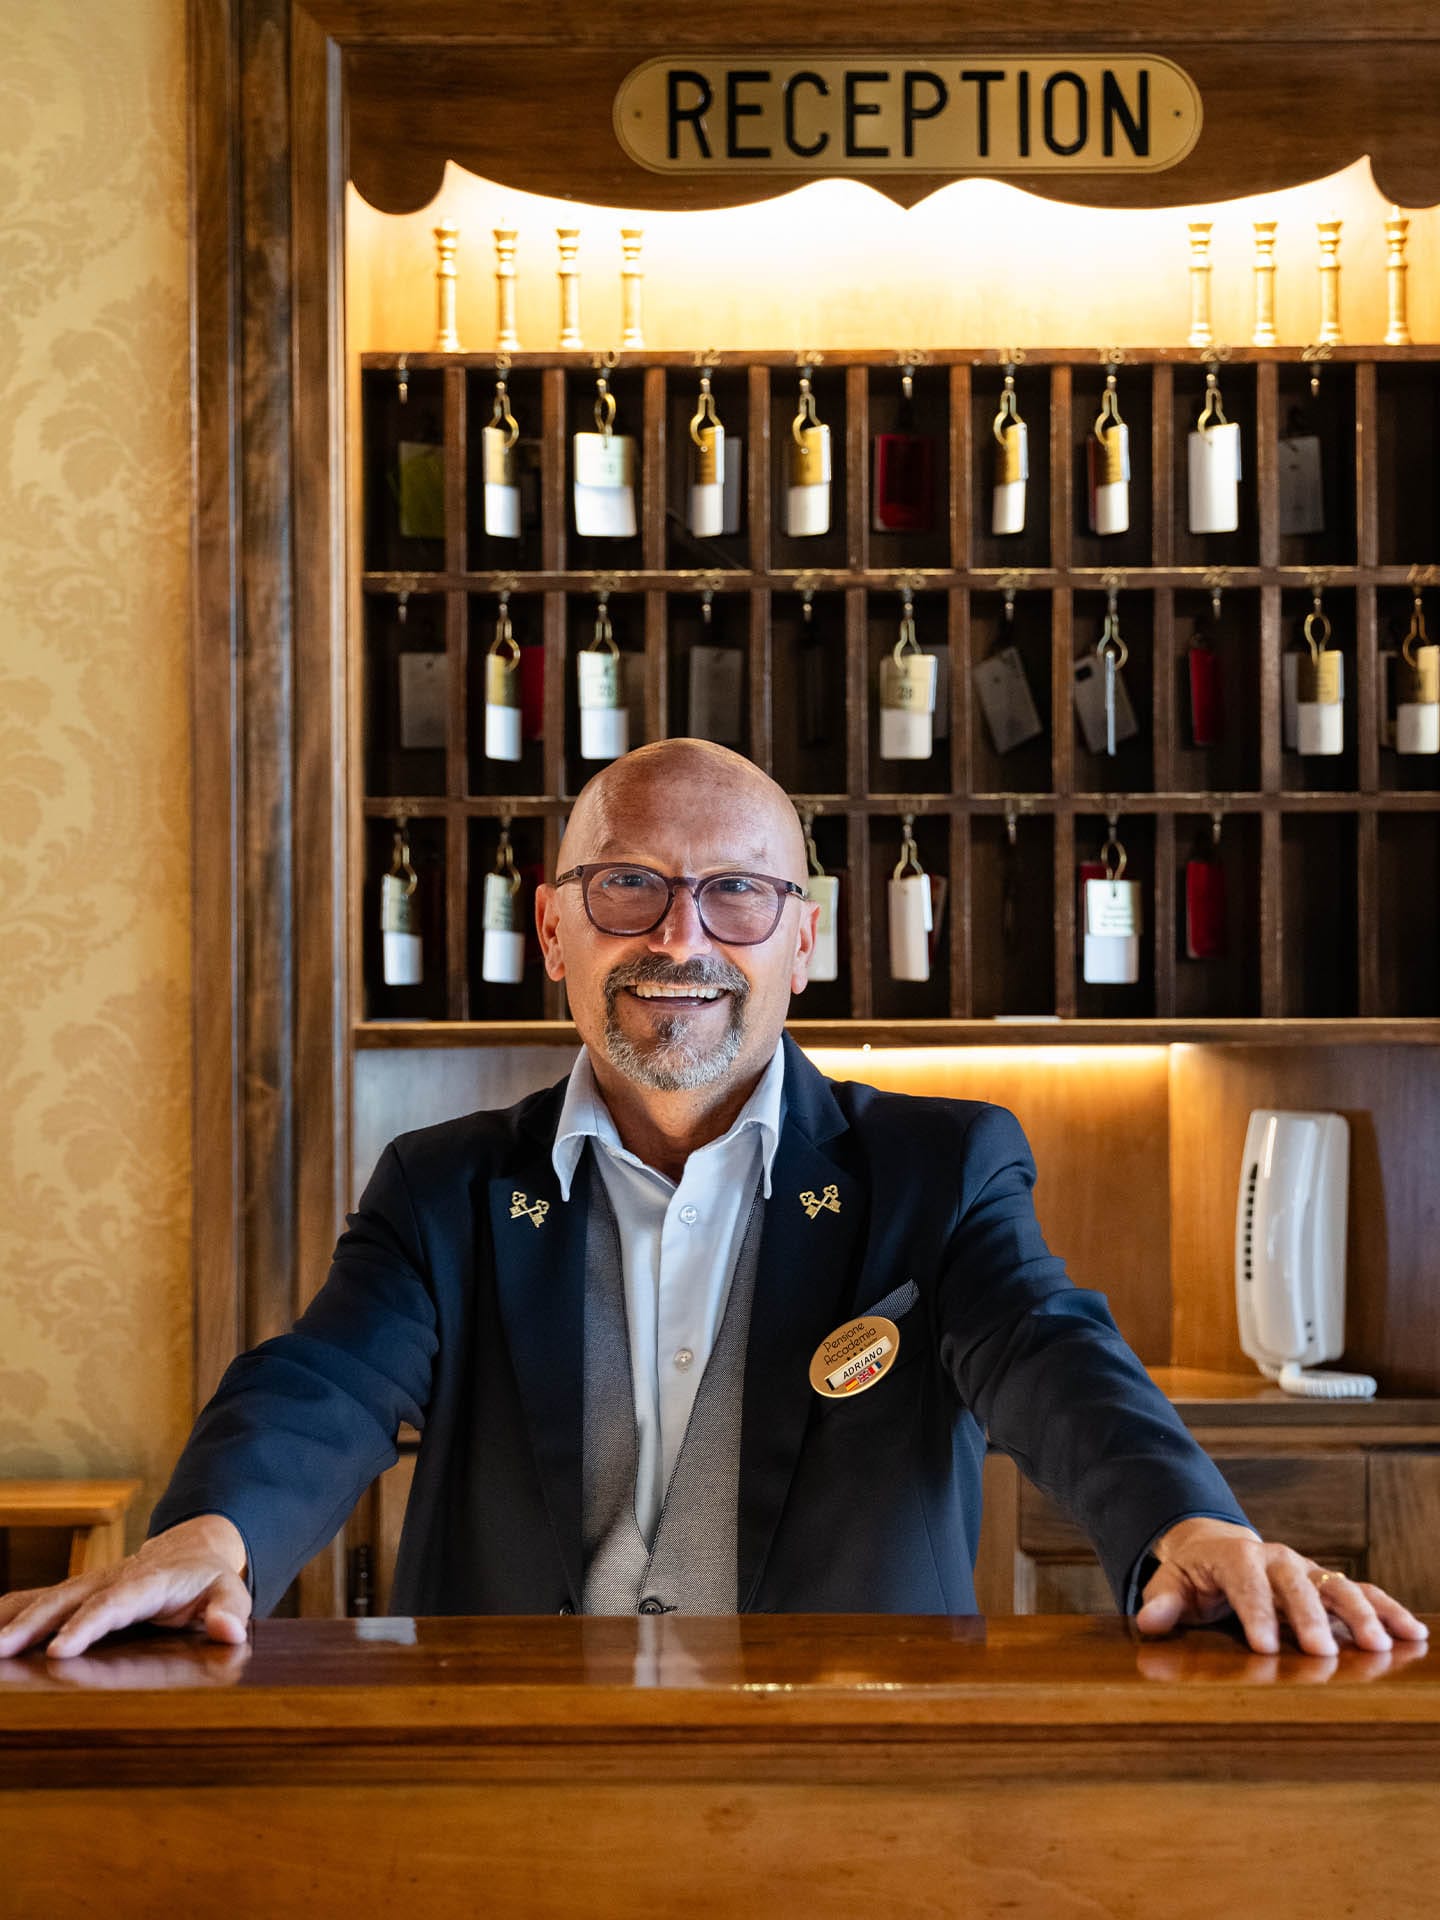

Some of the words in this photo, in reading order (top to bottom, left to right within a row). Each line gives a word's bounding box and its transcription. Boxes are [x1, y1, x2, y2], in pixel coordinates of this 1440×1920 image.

[666, 70, 1150, 159] RECEPTION
[823, 1322, 864, 1352] Pensione
[823, 1327, 876, 1366] Accademia
[843, 1347, 883, 1379] ADRIANO
